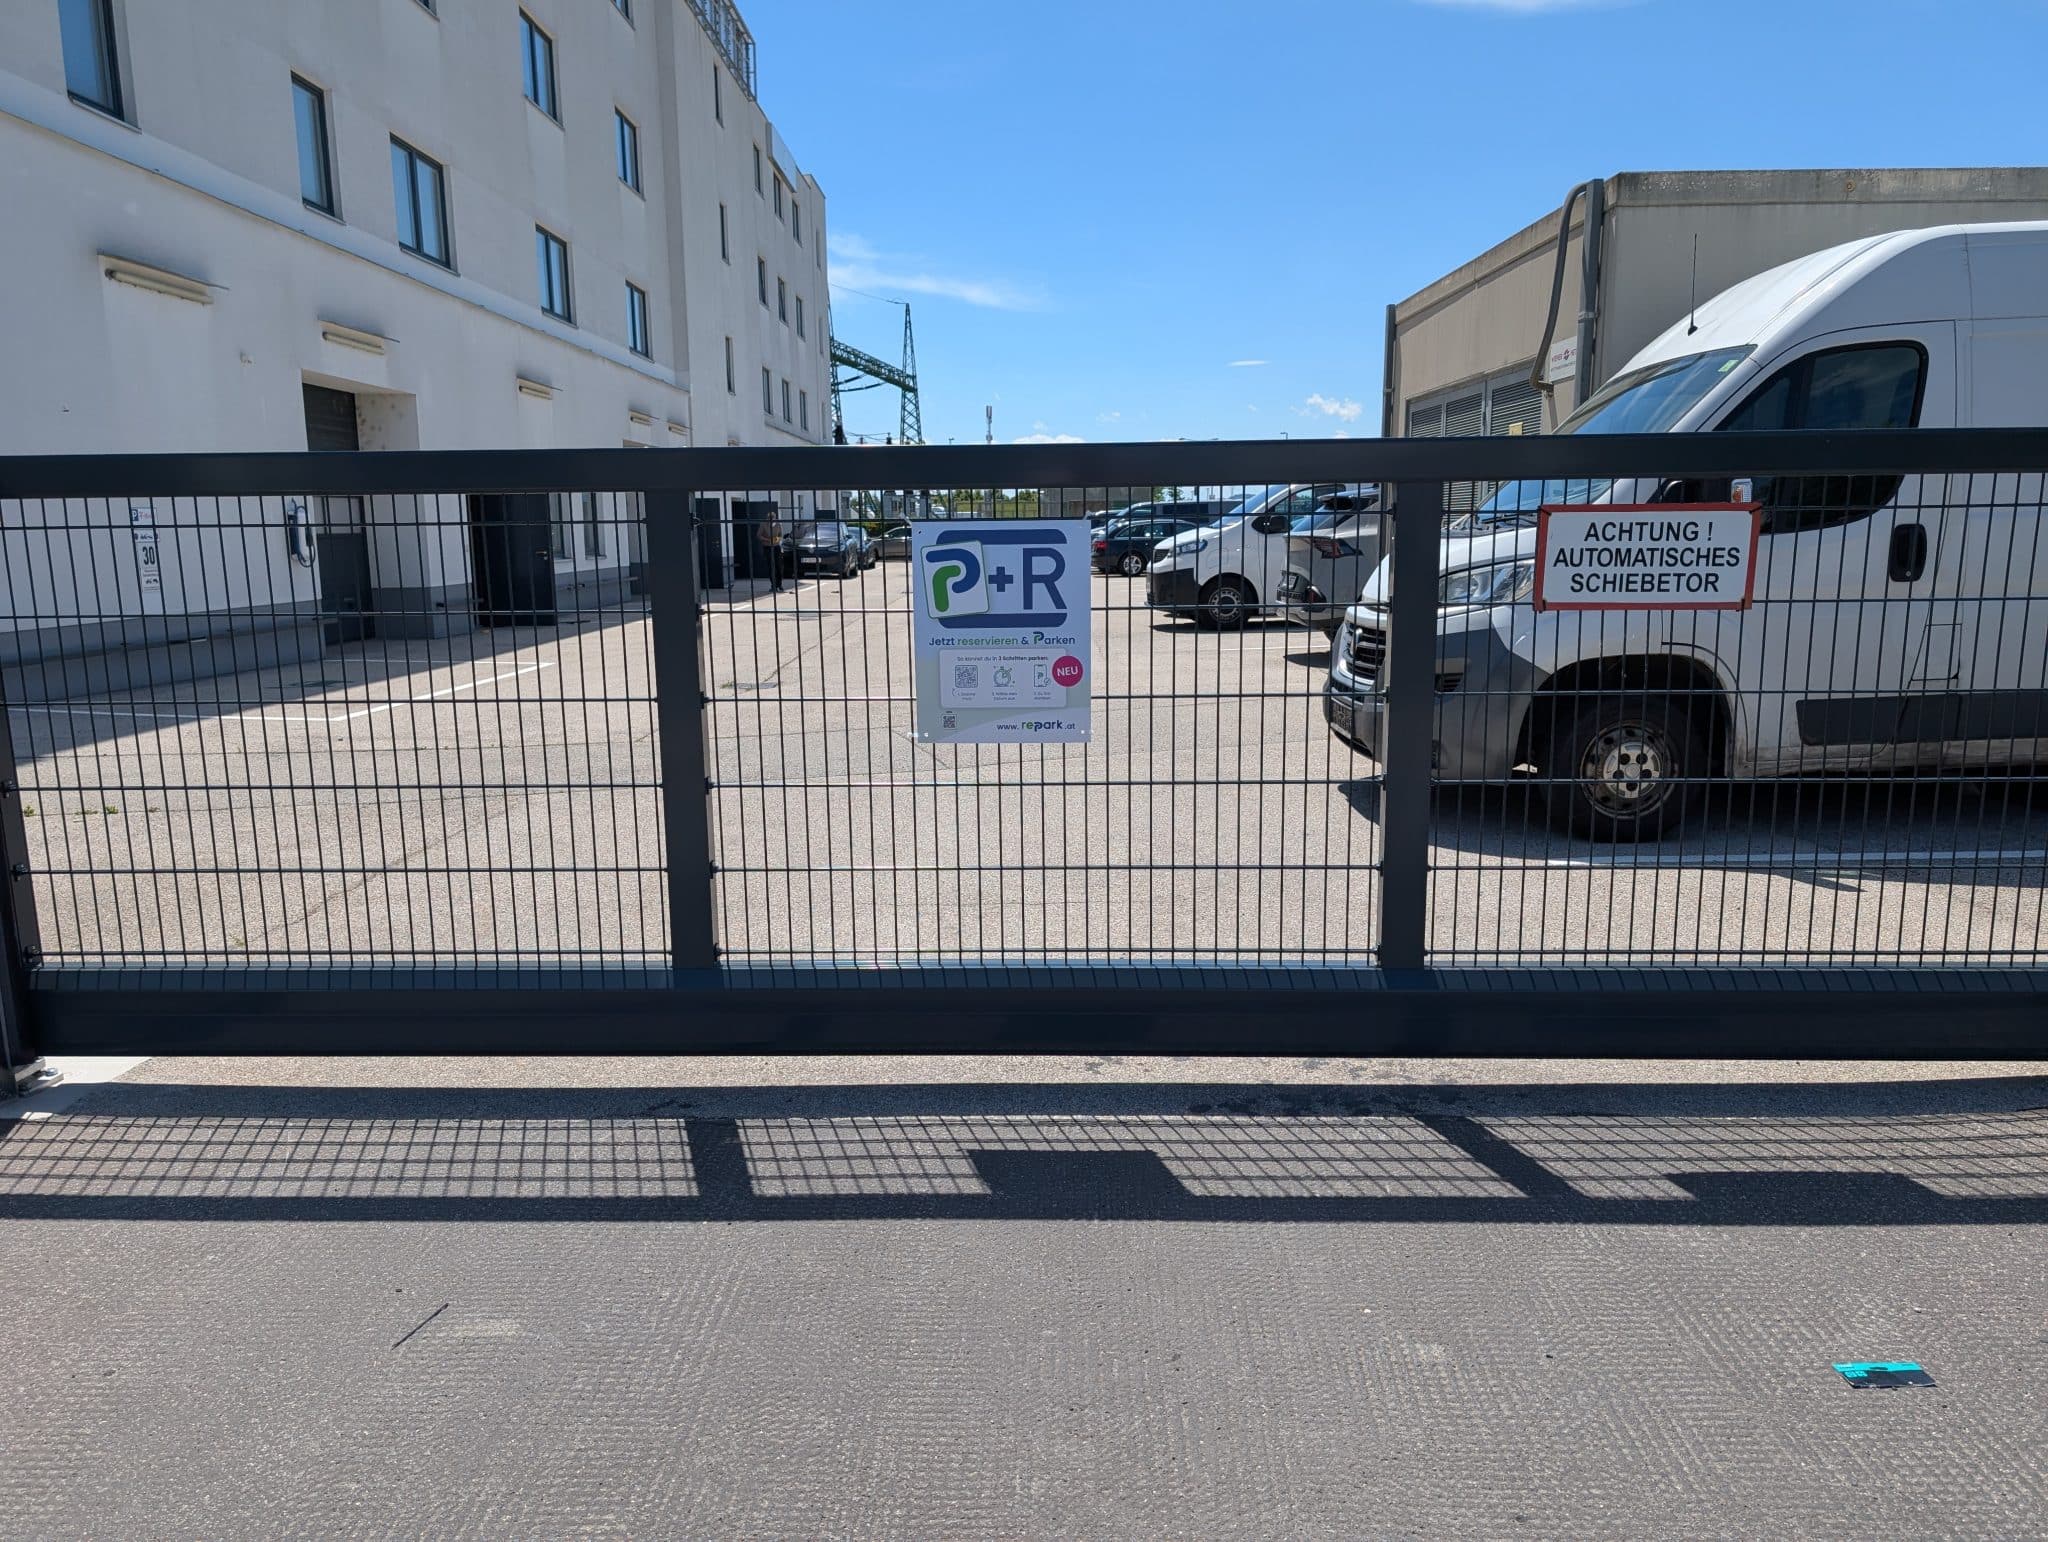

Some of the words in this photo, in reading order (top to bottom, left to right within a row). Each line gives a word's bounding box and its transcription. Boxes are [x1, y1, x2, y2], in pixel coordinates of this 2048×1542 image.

[142, 546, 155, 565] 30
[1553, 547, 1741, 568] AUTOMATISCHES
[1570, 572, 1719, 593] SCHIEBETOR
[928, 637, 955, 646] Jetzt
[957, 637, 1018, 646] reservieren
[1021, 637, 1029, 645] &
[1033, 631, 1076, 645] Parken
[1056, 666, 1079, 677] NEU
